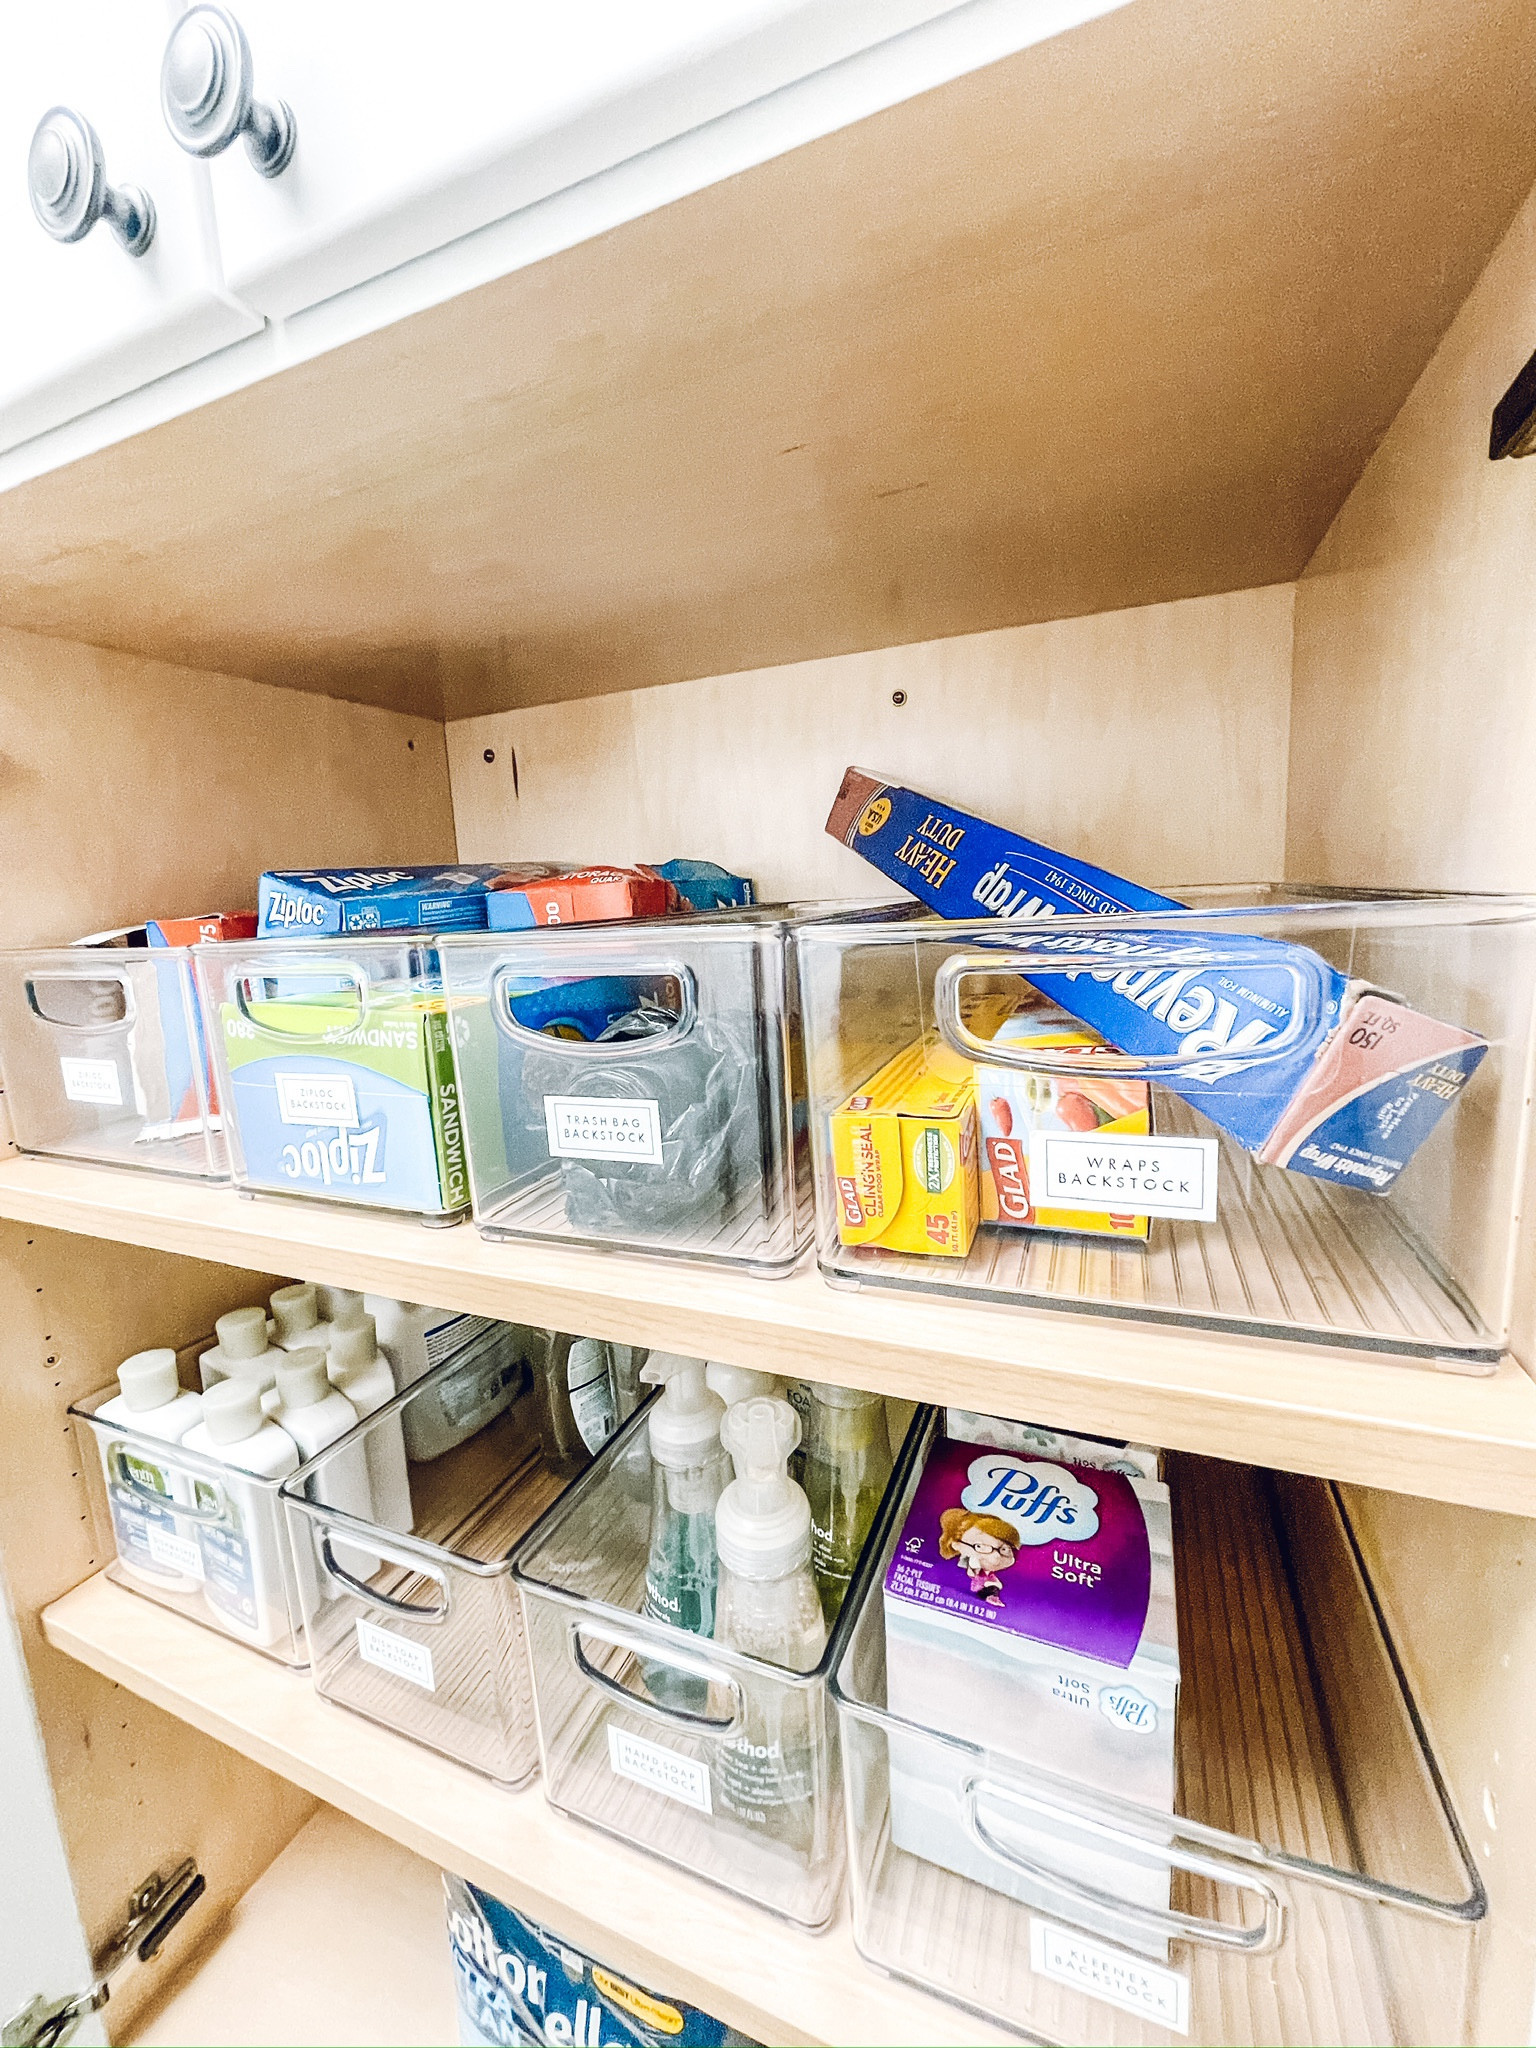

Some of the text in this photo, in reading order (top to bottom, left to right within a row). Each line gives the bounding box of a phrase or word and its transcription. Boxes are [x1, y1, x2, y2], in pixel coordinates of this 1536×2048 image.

[917, 814, 965, 851] DUTY
[894, 834, 957, 889] HEAVY
[301, 871, 415, 893] Ziploc
[1044, 870, 1066, 889] 1947
[1065, 883, 1101, 907] SINCE
[268, 891, 325, 929] Ziploc
[199, 924, 217, 944] 75
[1217, 976, 1292, 1018] ALUMINUM FOIL
[1349, 1026, 1384, 1050] 150
[299, 1088, 334, 1099] ZIPLOC
[1406, 1073, 1461, 1100] HEAVY
[290, 1100, 347, 1112] BACKSTOCK
[566, 1114, 641, 1128] TRASH BAG
[439, 1083, 465, 1204] SANDWICH
[564, 1128, 646, 1143] BACKSTOCK
[860, 1123, 873, 1161] SEAL
[282, 1127, 387, 1186] Ziploc
[1086, 1156, 1161, 1173] WRAPS
[1299, 1143, 1396, 1187] Reynolds Wrap
[927, 1172, 941, 1191] 2X
[993, 1142, 1030, 1219] GLAD
[1058, 1172, 1190, 1193] BACKSTOCK
[841, 1177, 863, 1225] GLAD
[926, 1214, 950, 1245] 45
[977, 1467, 1079, 1525] Puffs
[1053, 1550, 1102, 1575] Ultra
[893, 1572, 941, 1595] FACIAL TISSUES
[1051, 1567, 1095, 1589] Soft
[369, 1643, 423, 1672] BACKSTOCK
[1052, 1687, 1089, 1708] Ultra
[1058, 1675, 1090, 1694] Soft
[1109, 1695, 1148, 1726] Puffs
[624, 1746, 659, 1767] HAND
[662, 1758, 696, 1780] SOAP
[624, 1757, 698, 1794] BACKSTOCK
[1054, 1954, 1166, 2008] BACKSTOCK
[1070, 1949, 1149, 1989] KLEENEX
